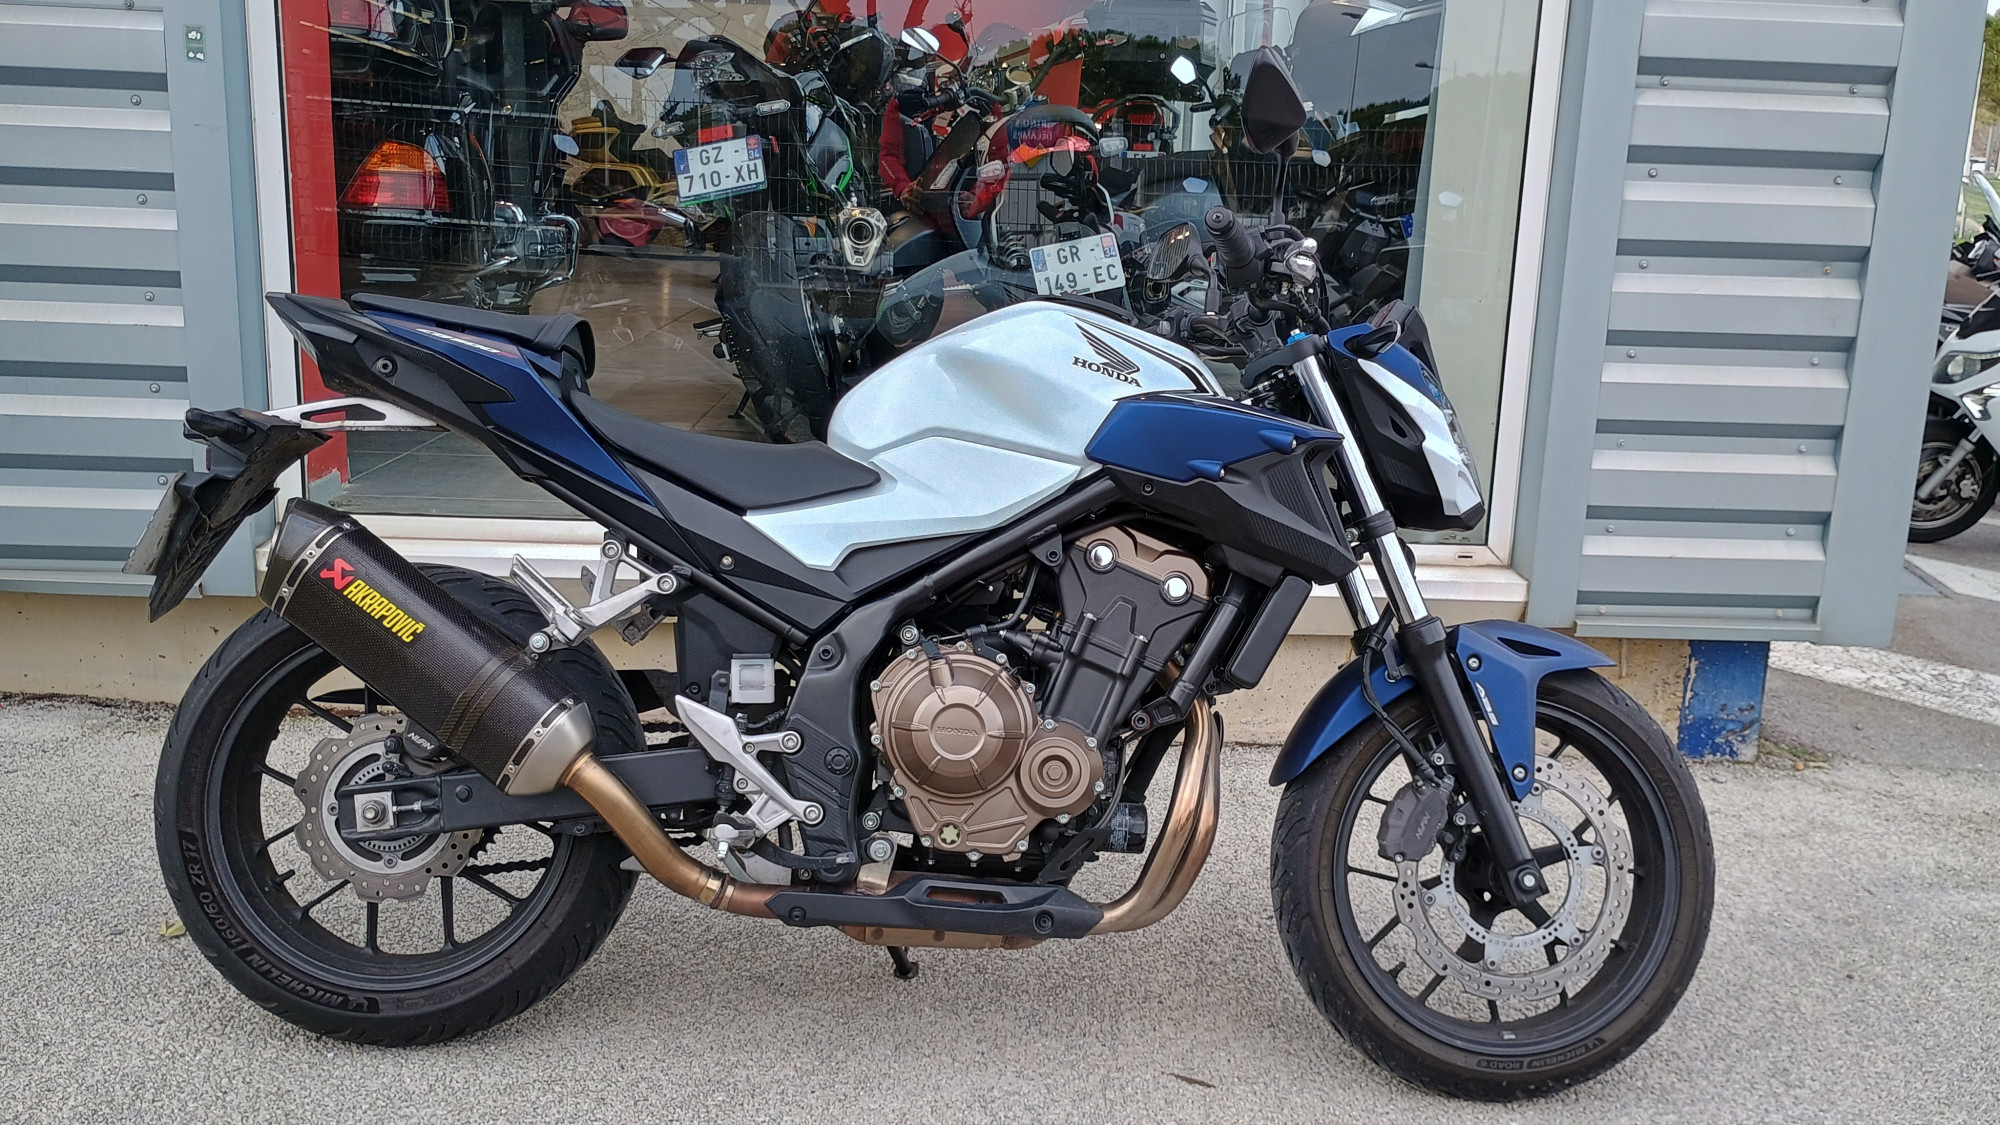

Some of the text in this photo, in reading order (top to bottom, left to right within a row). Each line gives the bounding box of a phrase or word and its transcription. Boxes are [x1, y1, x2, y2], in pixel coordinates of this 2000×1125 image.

[699, 145, 724, 166] GZ
[748, 150, 760, 159] 34
[683, 162, 759, 192] 710-XH
[1056, 245, 1081, 265] GR
[1072, 355, 1143, 389] HONDA
[936, 726, 979, 737] HONDA
[246, 954, 344, 1005] MICHELIN
